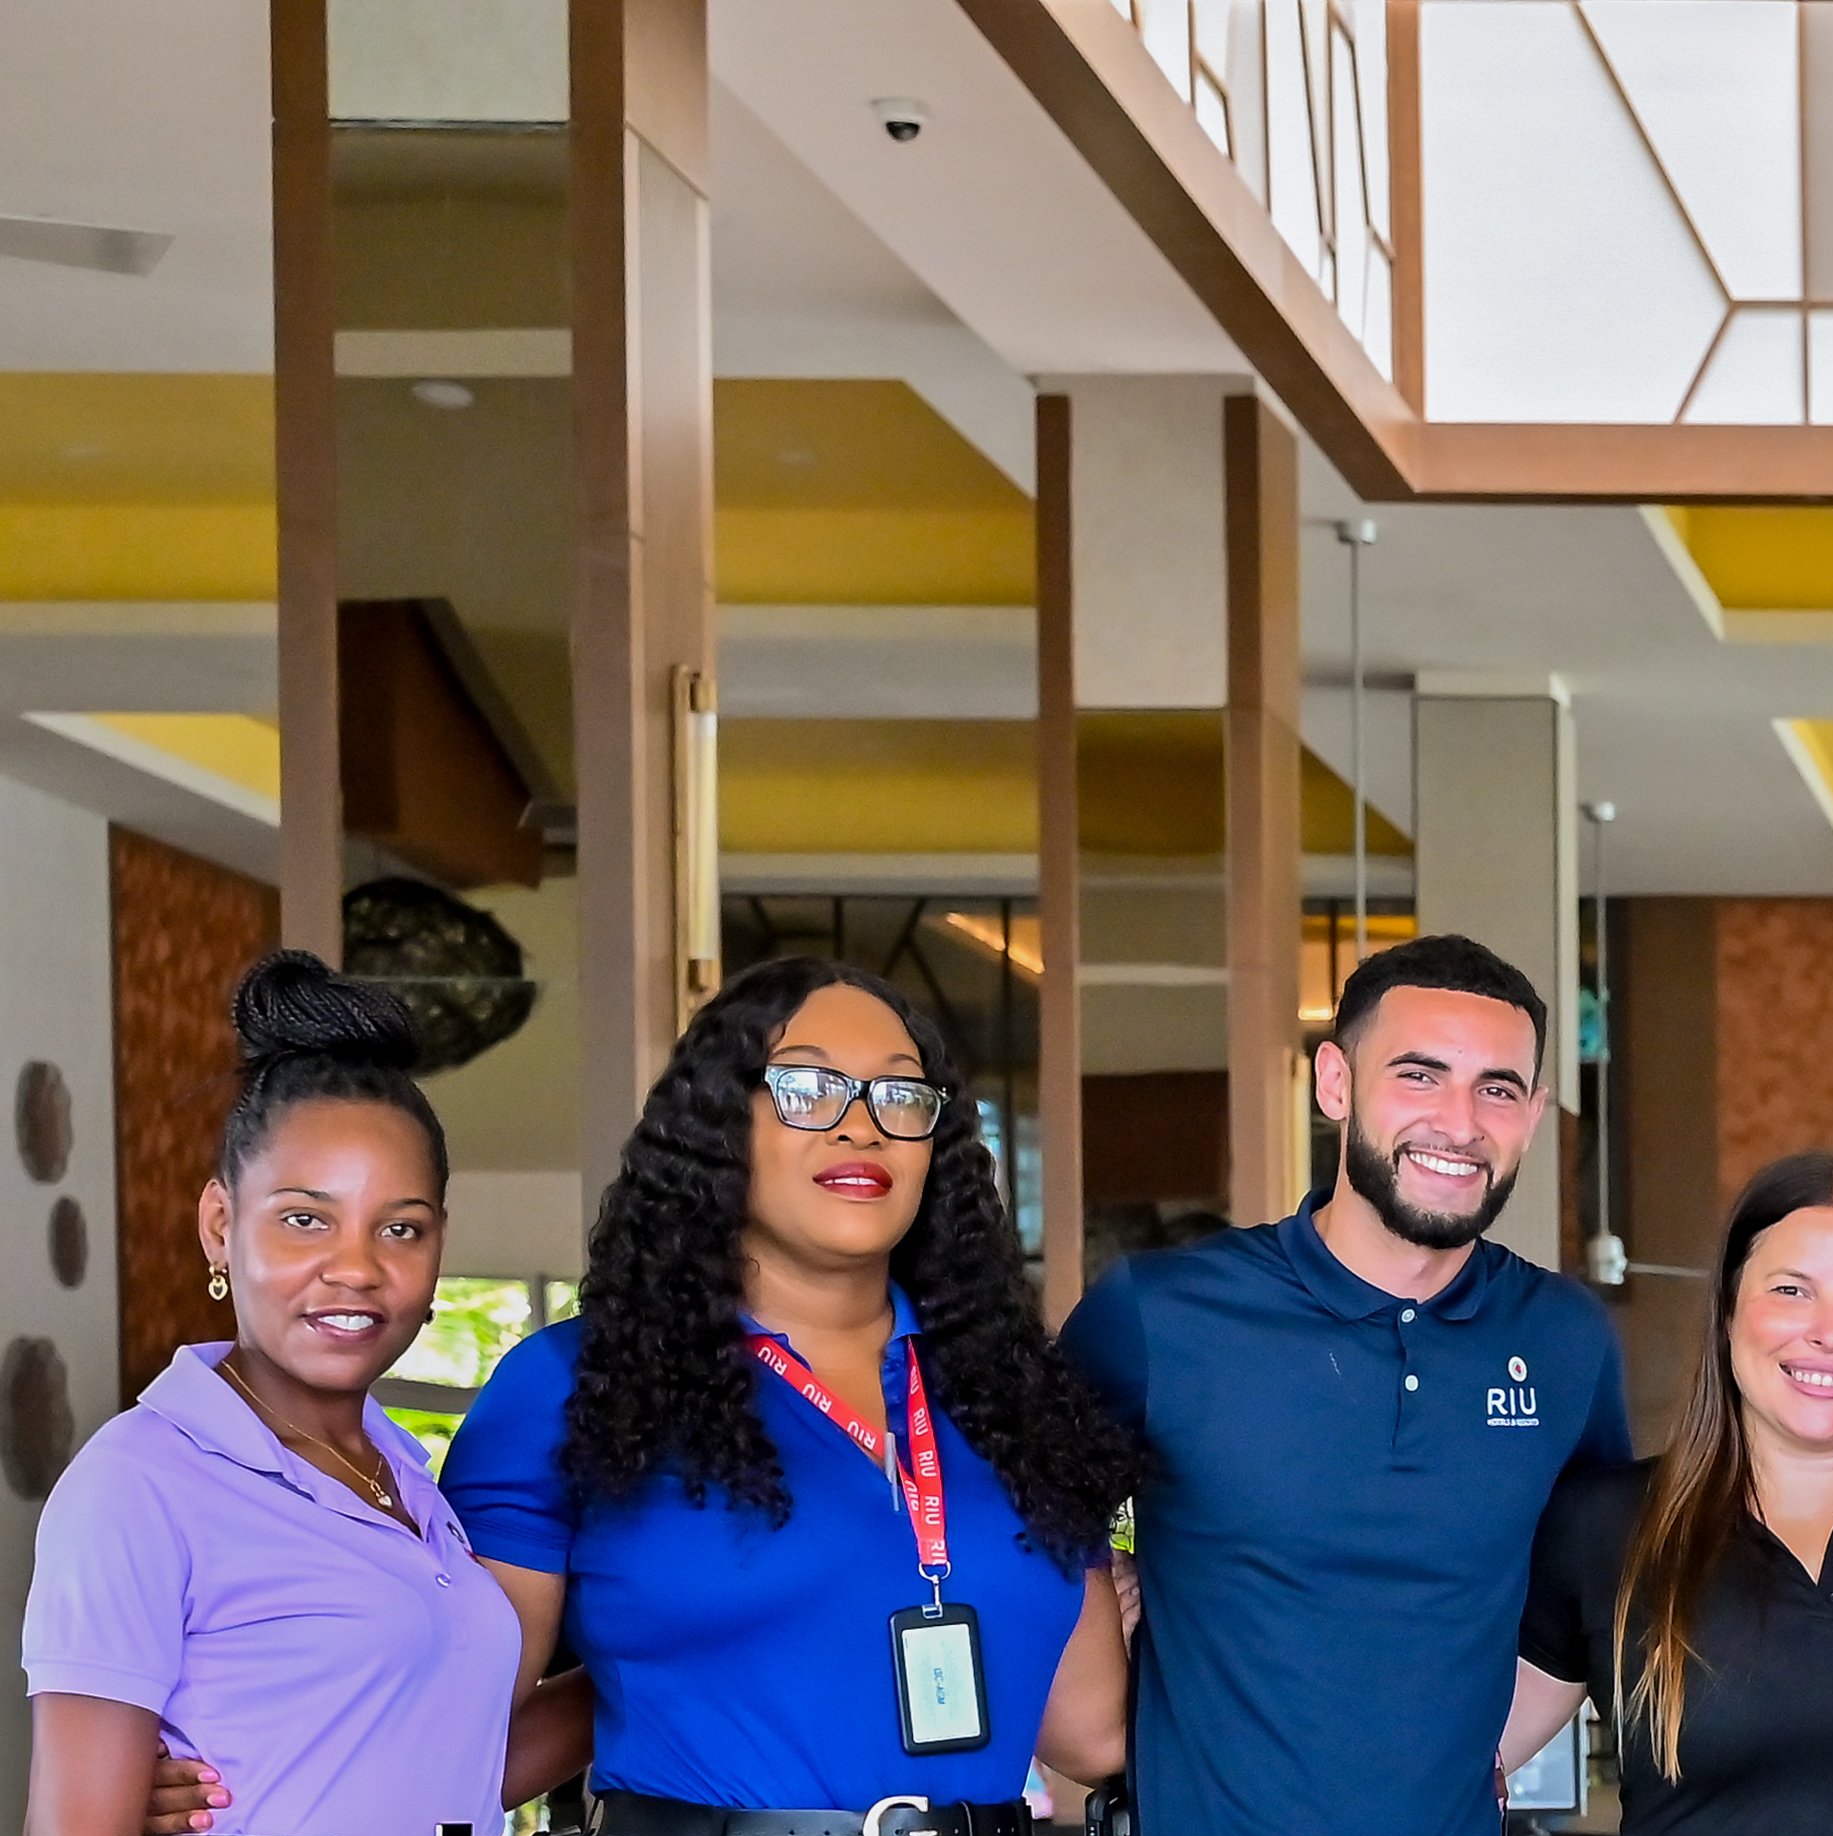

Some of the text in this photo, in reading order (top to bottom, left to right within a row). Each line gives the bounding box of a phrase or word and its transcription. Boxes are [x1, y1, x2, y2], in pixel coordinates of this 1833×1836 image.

[758, 1346, 788, 1376] RIU
[801, 1383, 832, 1414] RIU
[1486, 1387, 1537, 1416] RIU
[846, 1421, 876, 1450] RIU
[913, 1407, 929, 1436] RIU
[918, 1450, 937, 1477] RIU
[925, 1495, 940, 1525] RIU
